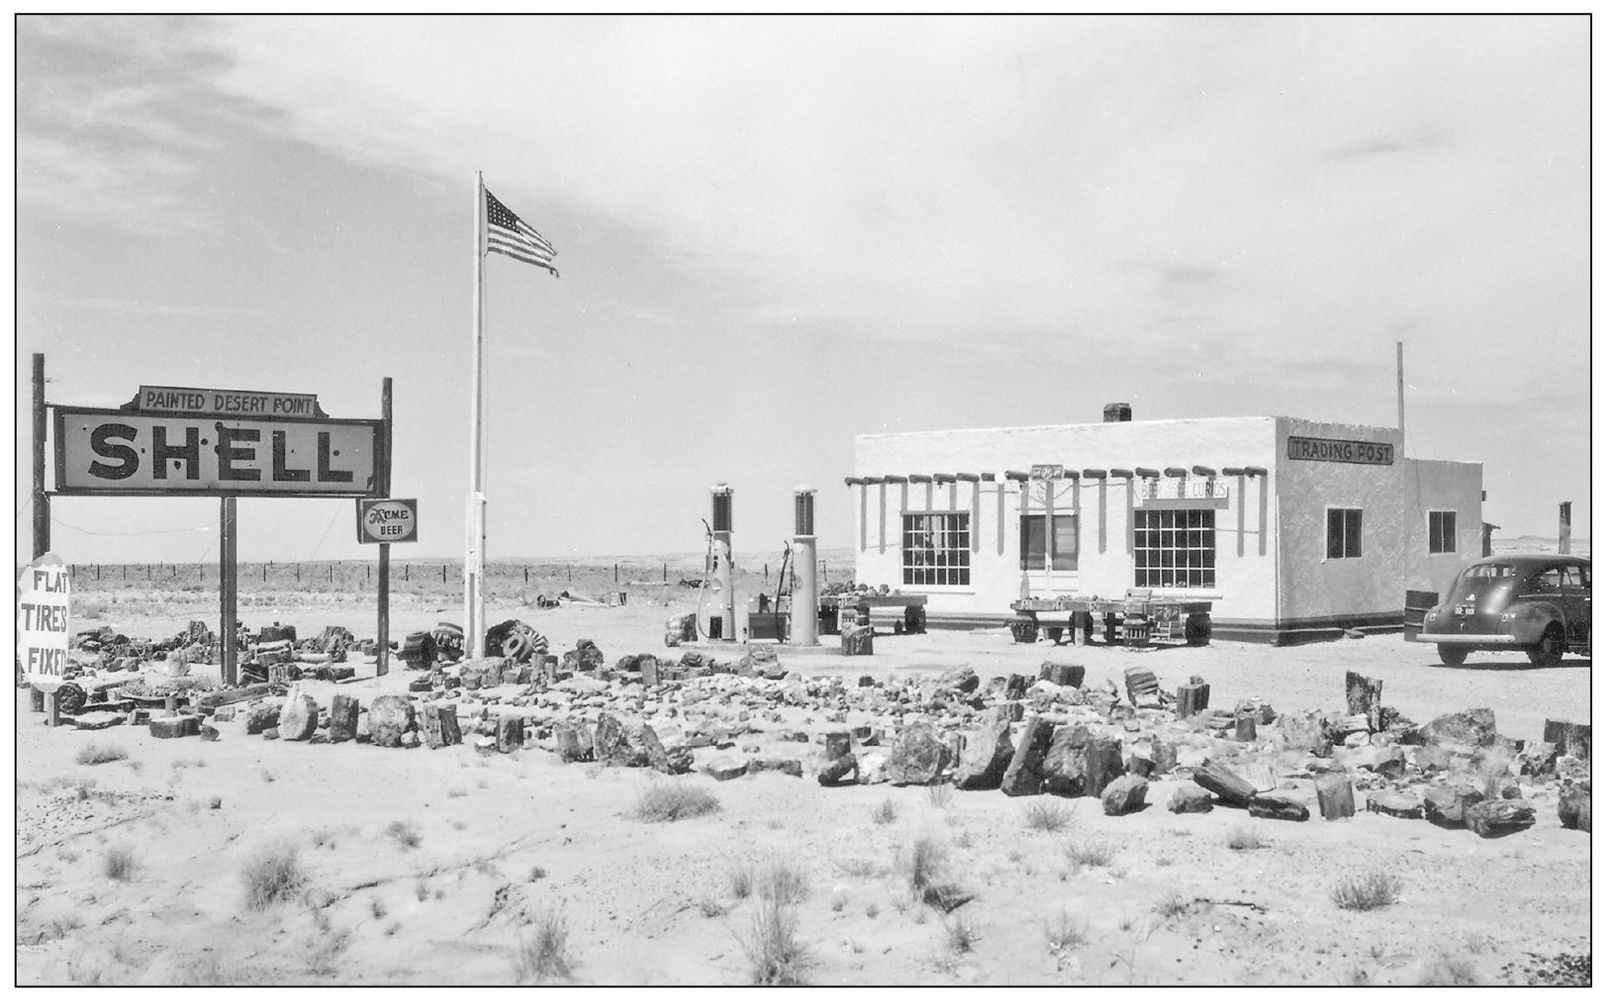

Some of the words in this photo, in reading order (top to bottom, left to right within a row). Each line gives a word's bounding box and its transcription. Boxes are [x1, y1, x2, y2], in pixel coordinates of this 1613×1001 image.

[146, 391, 205, 410] PAINTED
[214, 394, 268, 413] DESERT
[272, 397, 312, 415] POINT
[88, 422, 354, 482] SHELL
[1293, 439, 1352, 459] TRADING
[1357, 445, 1390, 461] POST
[1192, 480, 1227, 497] CURIOS
[368, 508, 409, 525] ACME
[380, 525, 403, 536] BEER
[33, 570, 67, 593] FLAT
[21, 603, 67, 632] TIRES
[28, 647, 67, 676] FIXED
